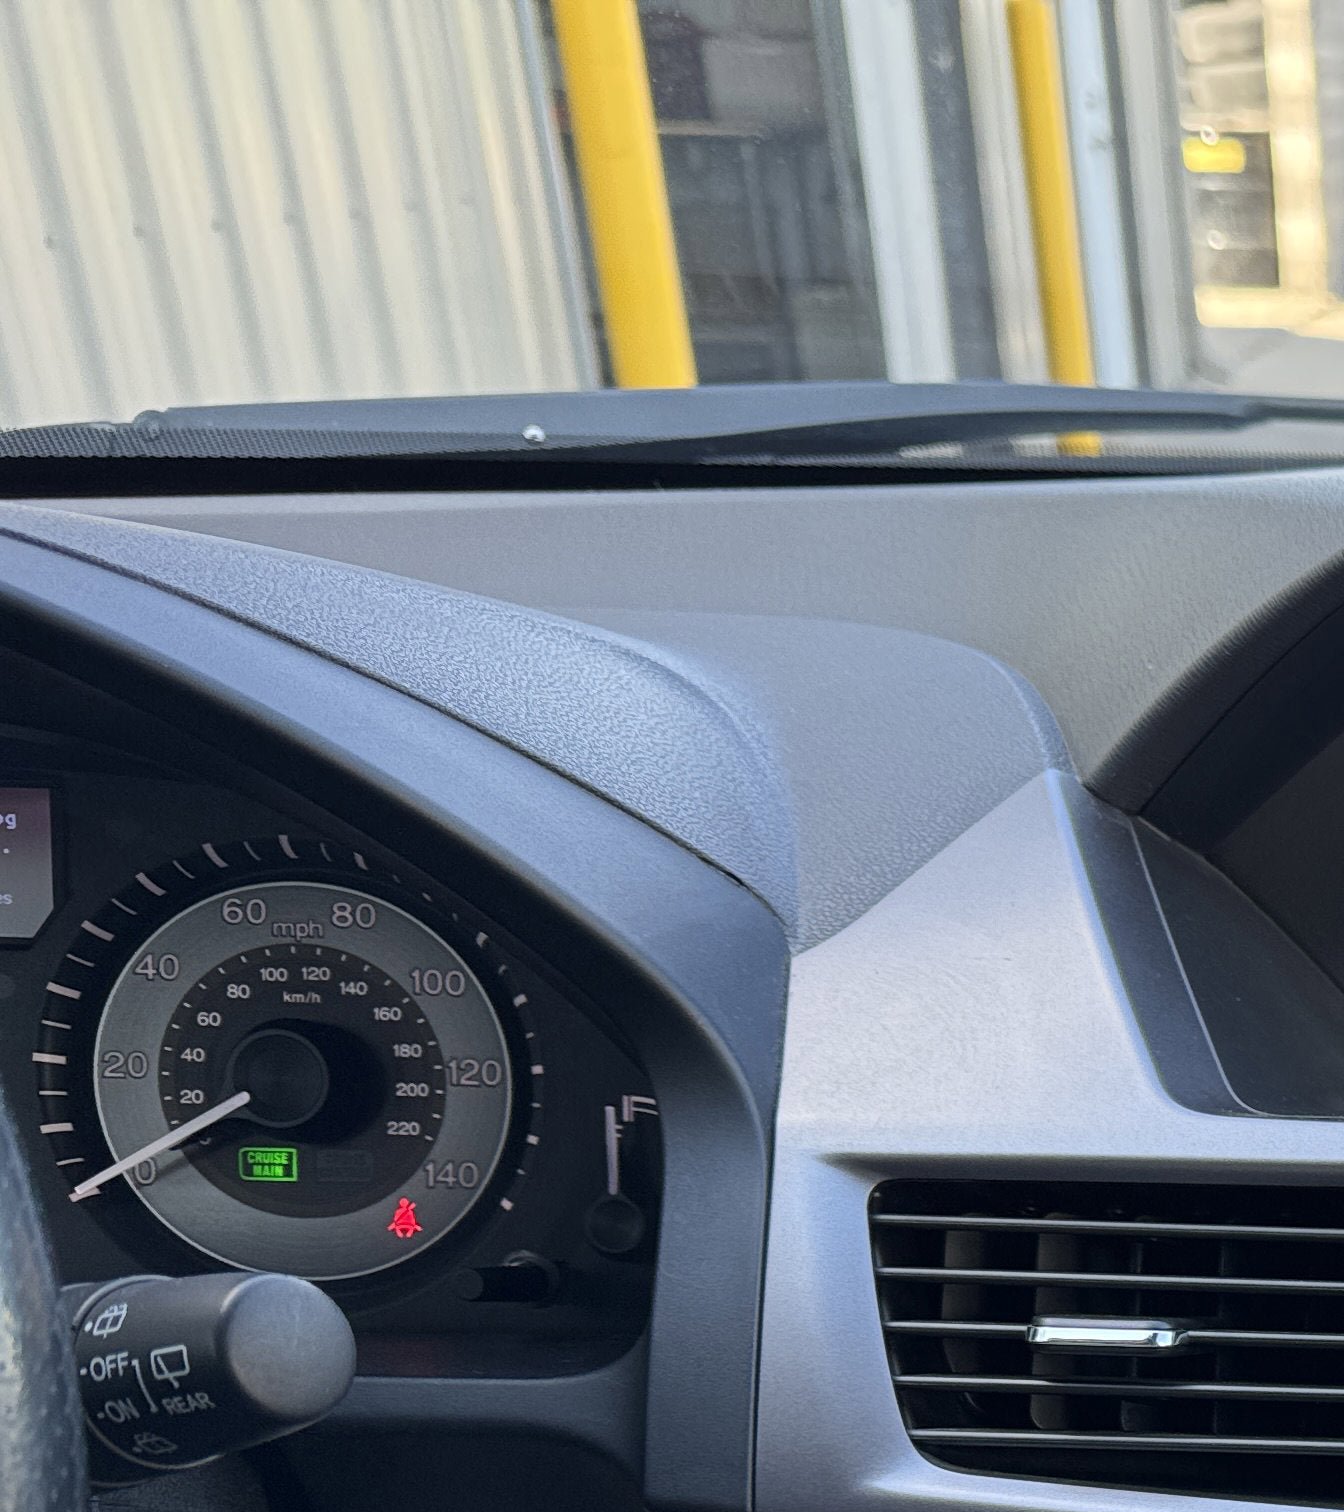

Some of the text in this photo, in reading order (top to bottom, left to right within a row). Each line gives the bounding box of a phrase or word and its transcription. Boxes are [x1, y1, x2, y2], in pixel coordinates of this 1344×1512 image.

[222, 898, 267, 925] 60
[331, 902, 376, 929] 80
[272, 918, 324, 941] mph
[135, 953, 180, 981] 40
[260, 967, 288, 982] 100
[301, 966, 330, 981] 120
[339, 981, 368, 997] 140
[410, 968, 465, 996] 100
[226, 984, 250, 999] 80
[282, 990, 321, 1004] km/h
[197, 1012, 222, 1027] 60
[373, 1007, 402, 1021] 160
[181, 1047, 205, 1062] 40
[393, 1044, 422, 1058] 180
[102, 1051, 148, 1078] 20
[447, 1059, 501, 1086] 120
[179, 1089, 204, 1104] 20
[395, 1083, 429, 1097] 200
[387, 1121, 421, 1136] 220
[247, 1151, 289, 1165] CRUISE
[132, 1157, 157, 1185] 0
[252, 1164, 284, 1177] MAIN
[424, 1162, 479, 1189] 140
[89, 1351, 129, 1382] OFF
[104, 1397, 140, 1424] ON
[161, 1391, 217, 1415] REAR
